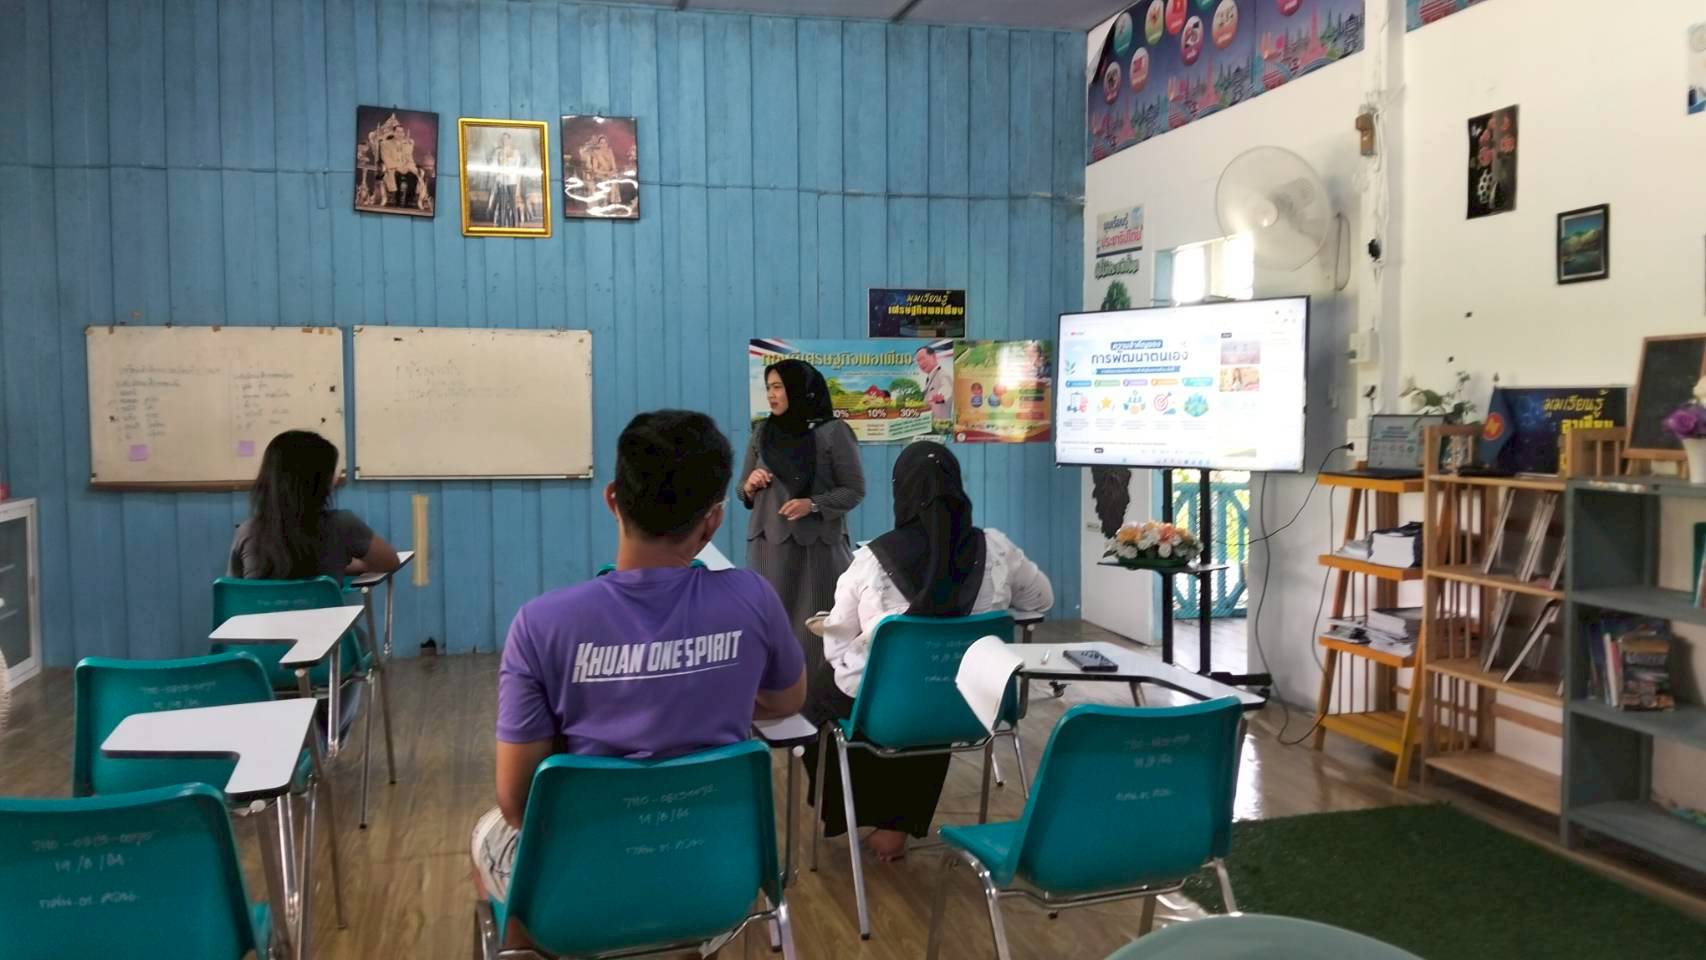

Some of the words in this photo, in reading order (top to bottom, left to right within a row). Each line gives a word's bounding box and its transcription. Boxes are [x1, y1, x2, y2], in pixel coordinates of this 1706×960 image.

[906, 290, 952, 308] มุมเรียนรู้
[888, 305, 964, 316] เศรษฐกิจพอเพียง
[1091, 351, 1189, 364] การพัฒนาตนเอง
[1543, 389, 1609, 418] มุมเรียนรู้
[867, 408, 887, 418] 10%
[900, 408, 920, 418] 30%
[572, 642, 646, 683] KHUAN
